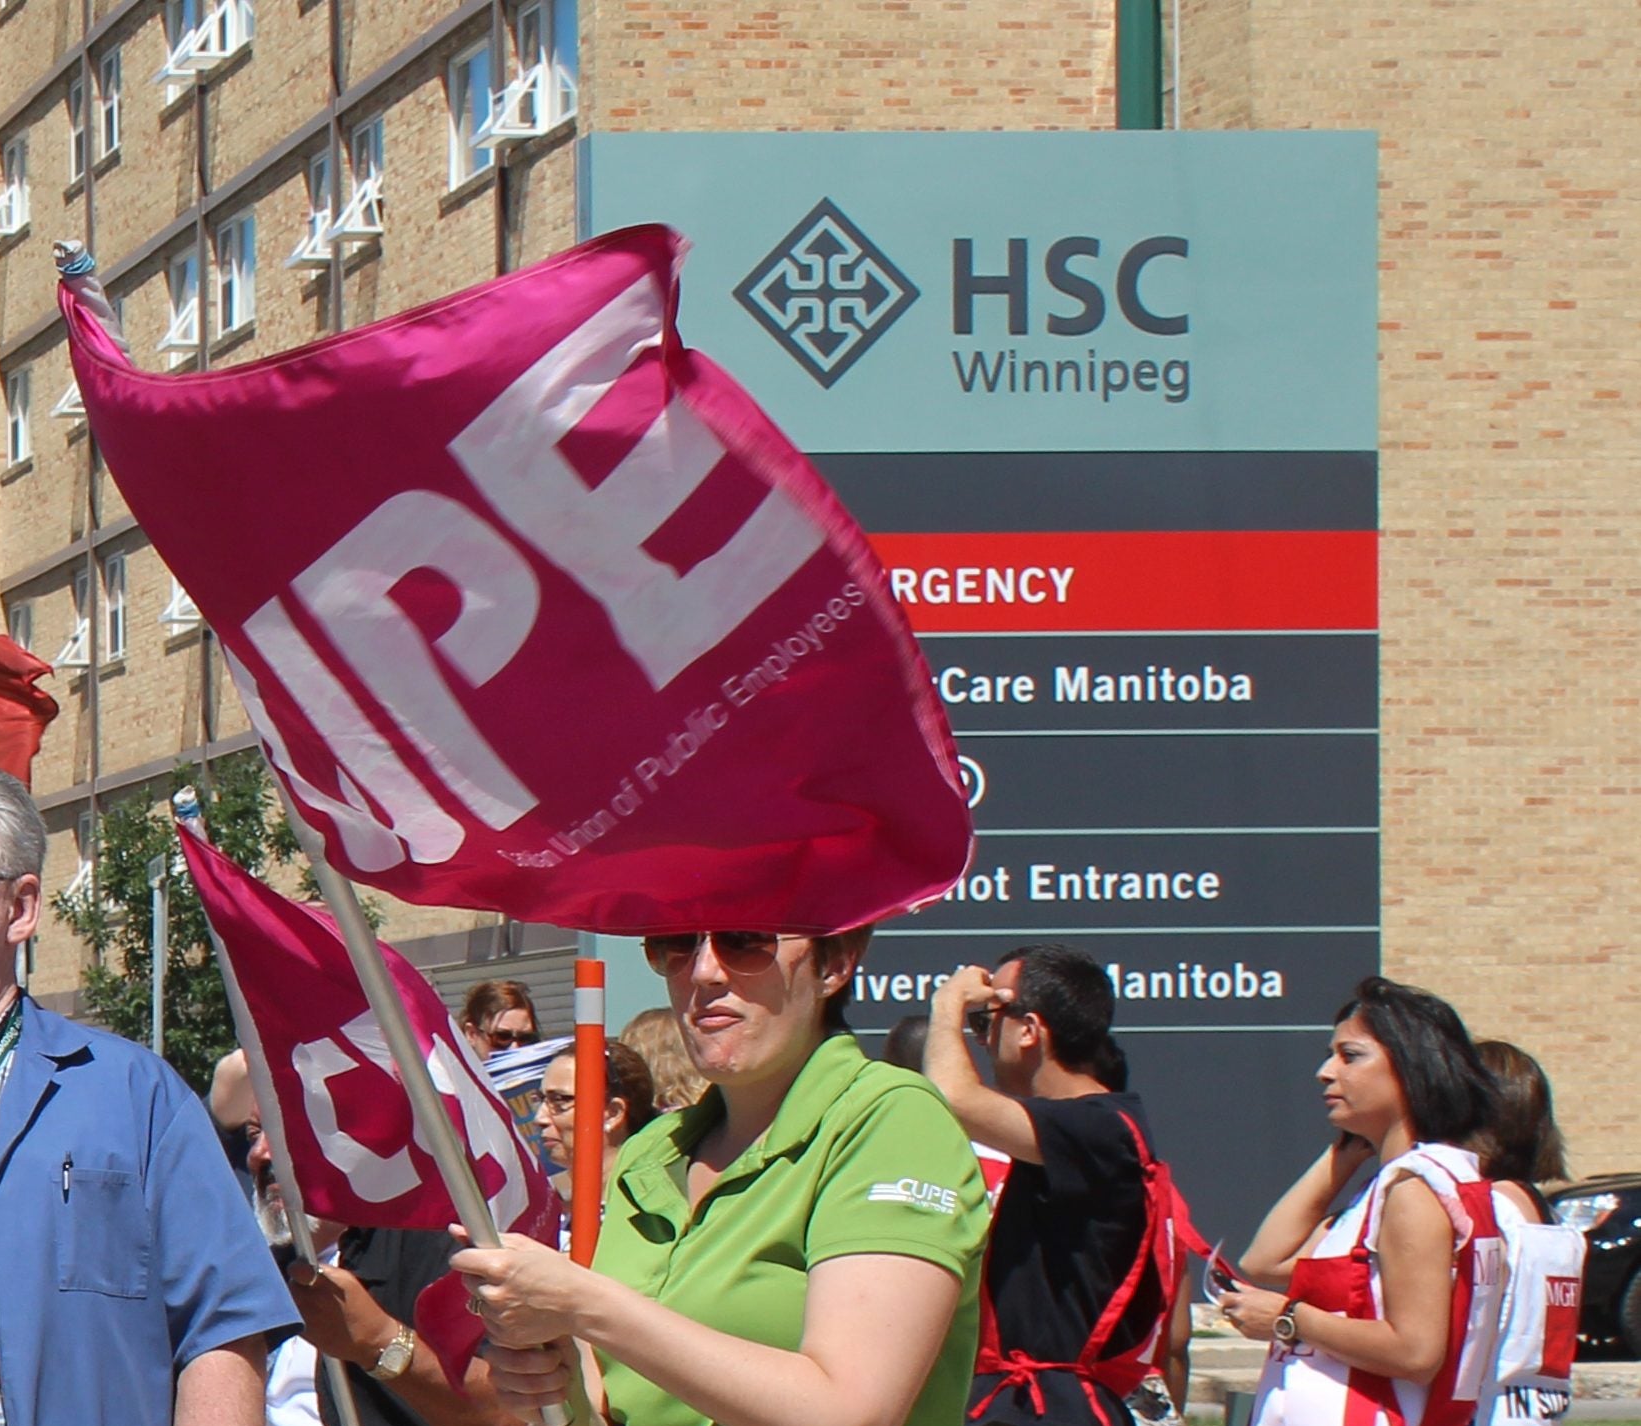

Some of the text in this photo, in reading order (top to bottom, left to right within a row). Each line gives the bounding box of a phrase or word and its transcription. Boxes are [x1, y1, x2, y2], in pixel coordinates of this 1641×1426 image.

[953, 237, 1190, 338] HSC
[952, 350, 1191, 402] Winnipeg
[889, 567, 1074, 604] RGENCY
[633, 702, 730, 792] Public
[720, 582, 865, 708] Employees
[1055, 666, 1254, 703] Manitoba
[1030, 865, 1220, 900] Entrance
[897, 1178, 958, 1207] CUPE
[1505, 1385, 1530, 1419] IN
